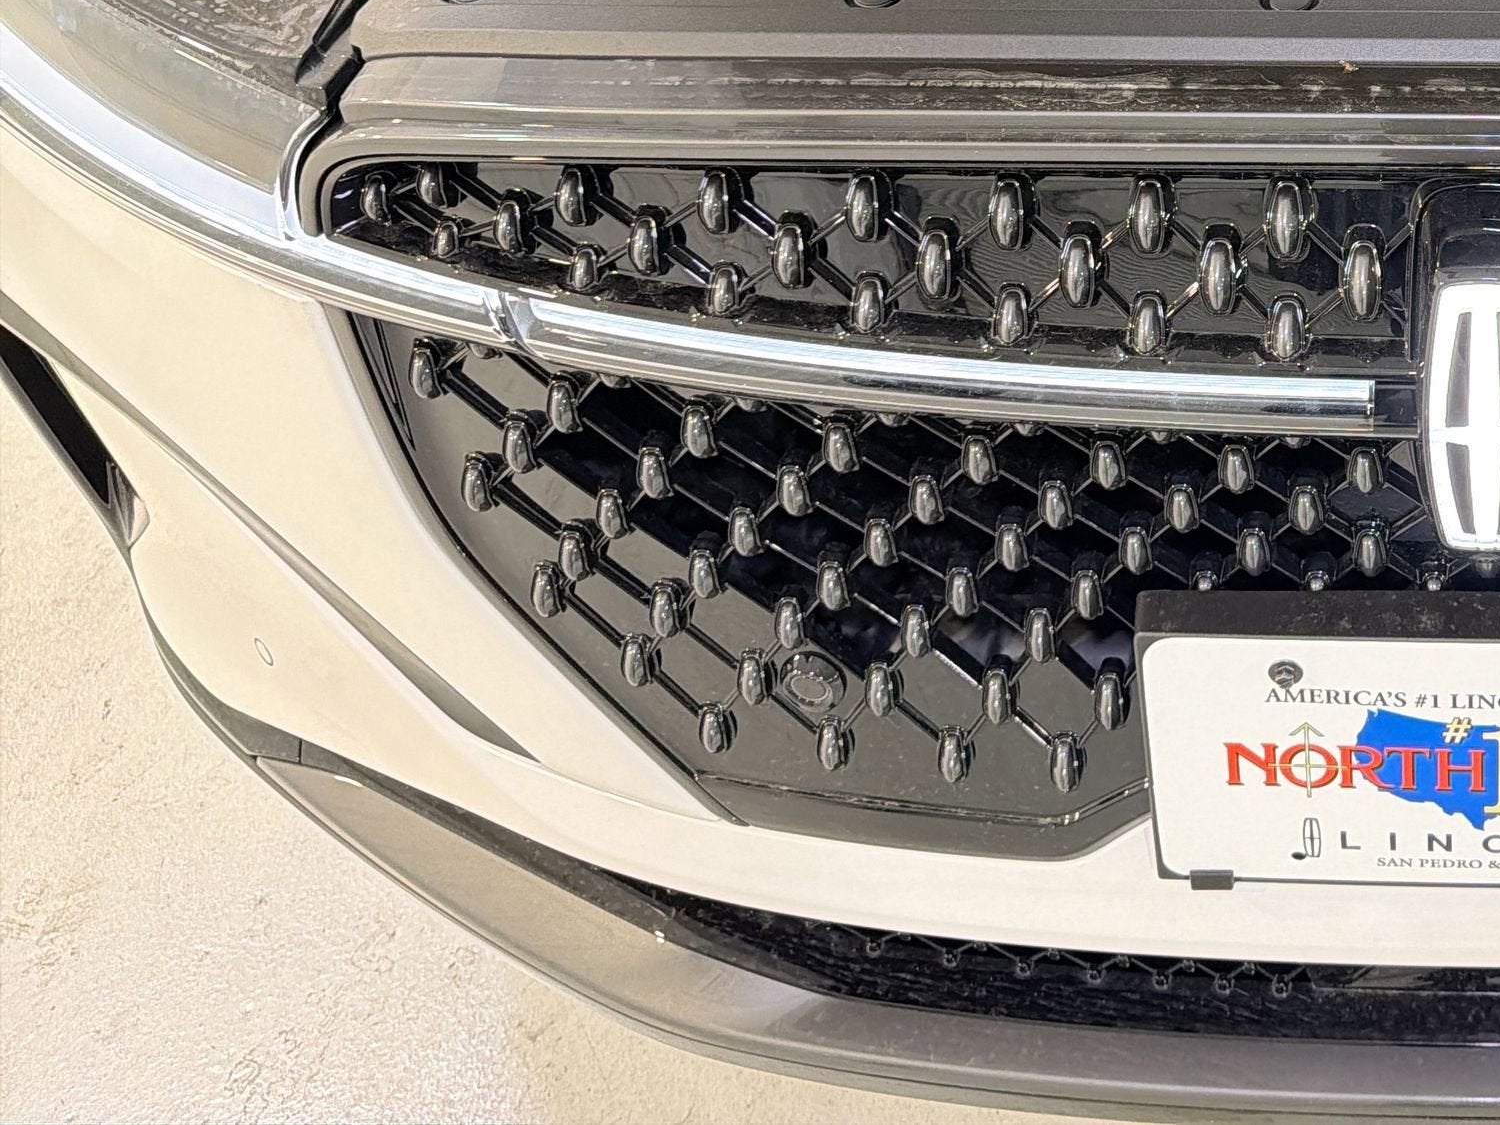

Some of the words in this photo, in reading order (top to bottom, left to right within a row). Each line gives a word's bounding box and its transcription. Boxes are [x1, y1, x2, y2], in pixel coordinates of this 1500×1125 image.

[1264, 688, 1407, 707] AMERICA'S
[1414, 693, 1441, 709] #1
[1223, 742, 1488, 792] NORTH
[1377, 857, 1413, 868] SAN
[1419, 858, 1483, 869] PEDRO
